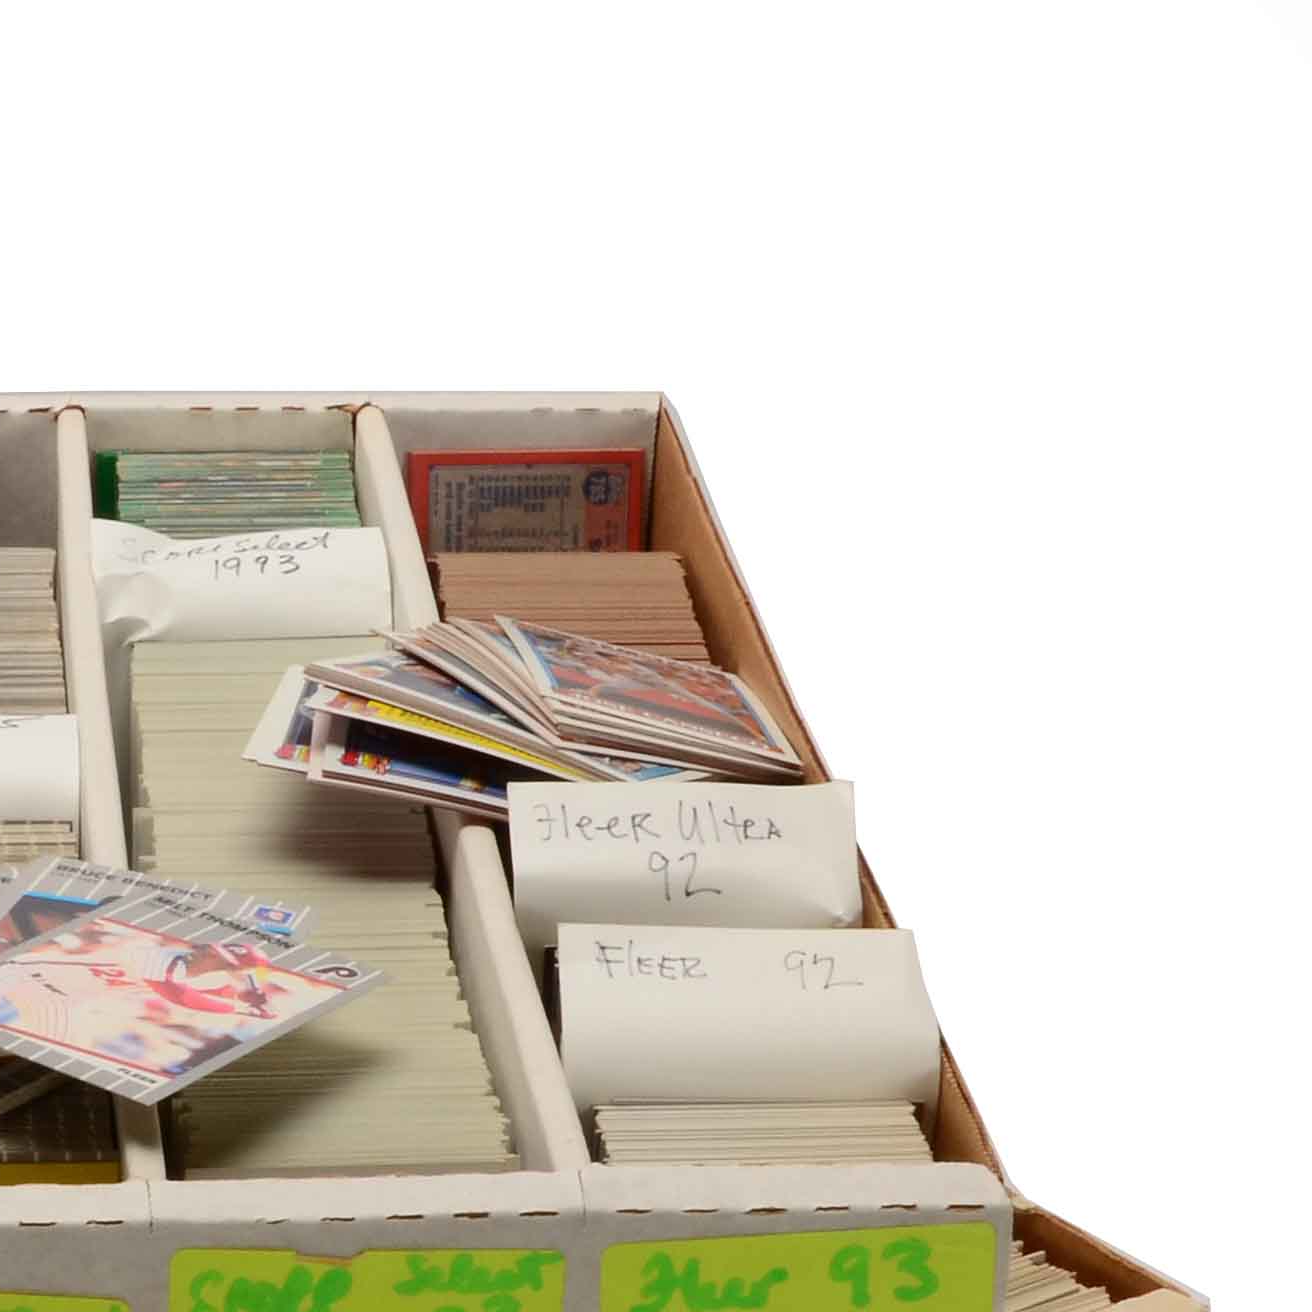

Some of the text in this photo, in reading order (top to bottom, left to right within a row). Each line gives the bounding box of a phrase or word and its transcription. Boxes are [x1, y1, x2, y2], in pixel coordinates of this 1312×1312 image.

[214, 555, 301, 580] 1993
[647, 850, 722, 900] 92
[785, 950, 864, 989] 92
[830, 1237, 940, 1309] 93
